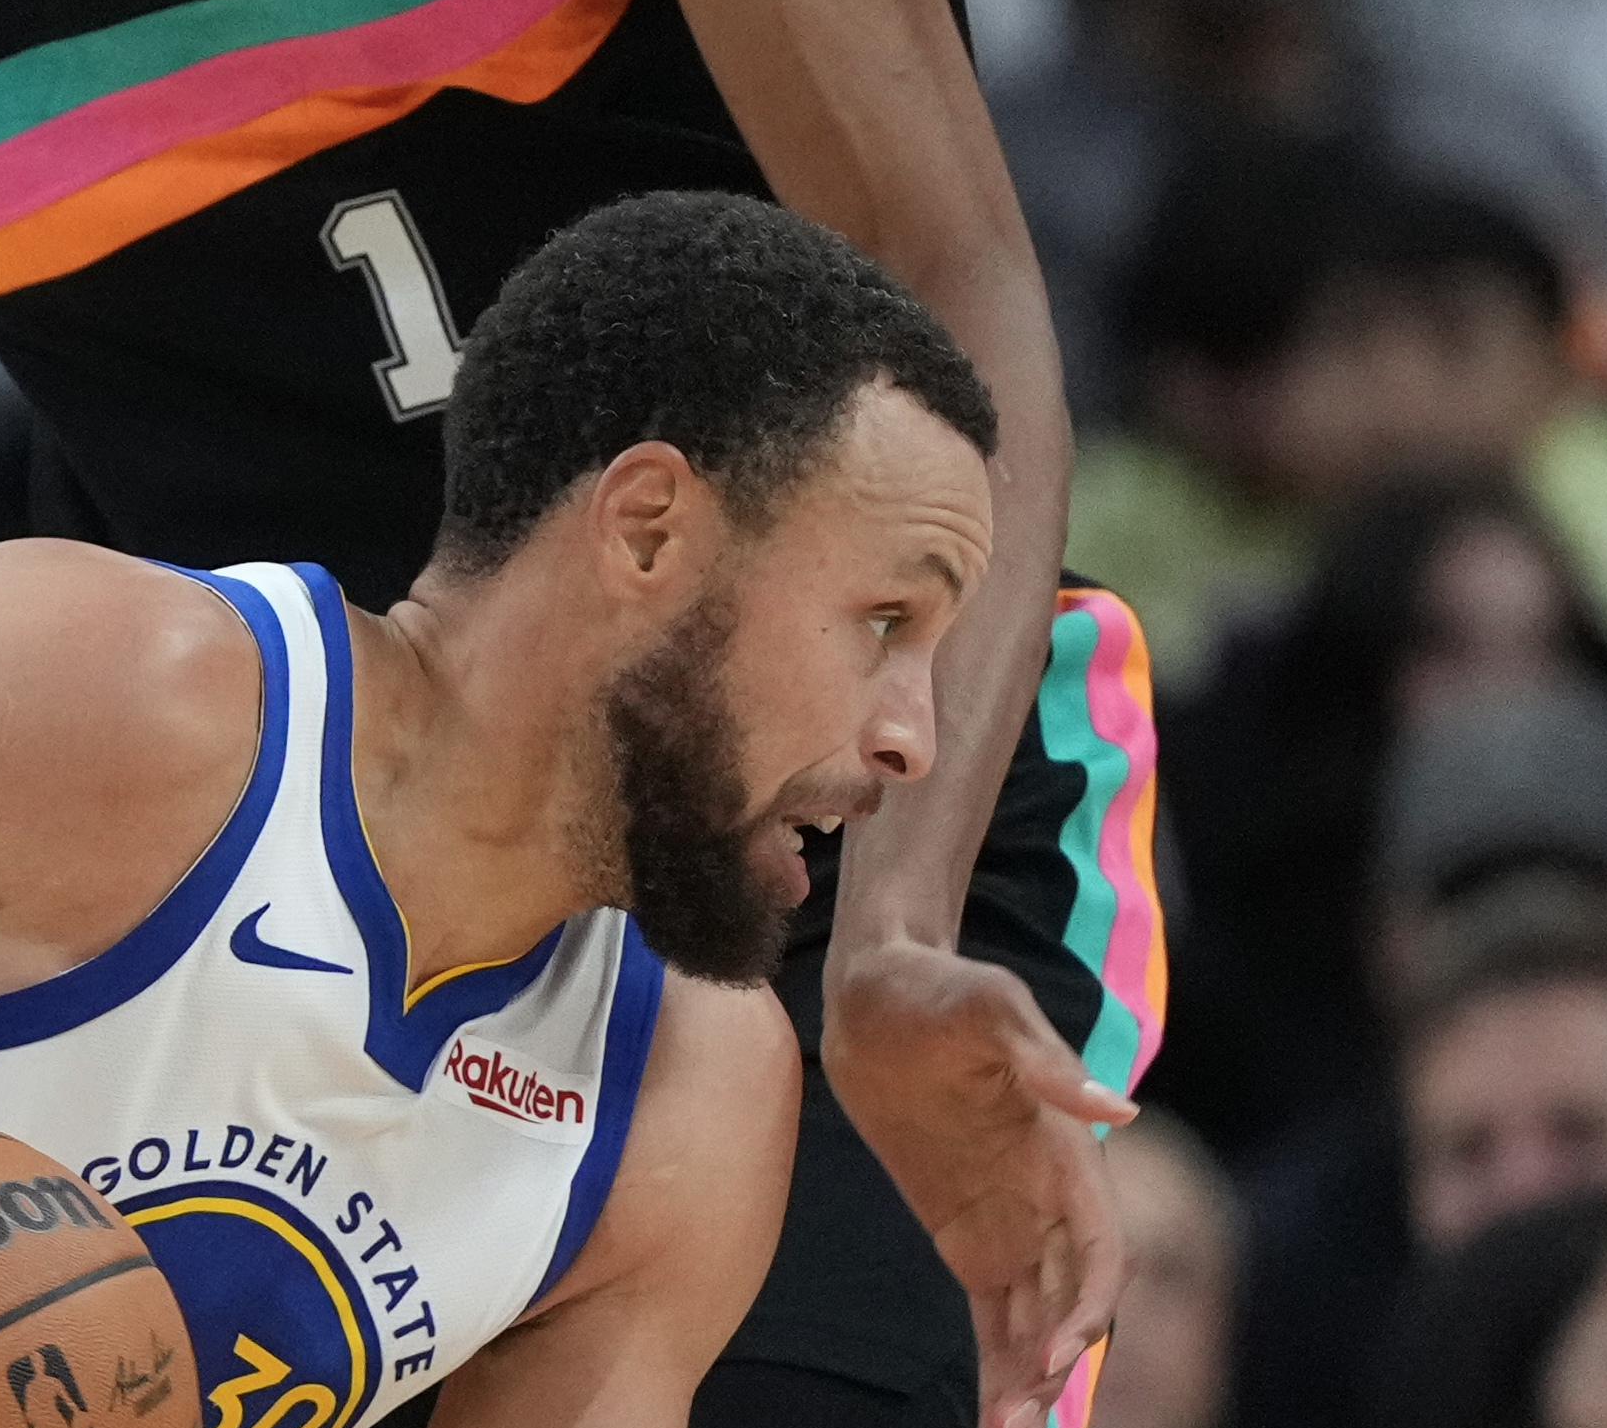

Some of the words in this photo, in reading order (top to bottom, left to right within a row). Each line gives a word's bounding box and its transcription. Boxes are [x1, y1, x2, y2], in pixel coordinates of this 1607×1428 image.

[319, 188, 466, 424] 1
[444, 1038, 584, 1124] Rakuten
[81, 1124, 328, 1196] GOLDEN
[336, 1191, 436, 1383] STATE
